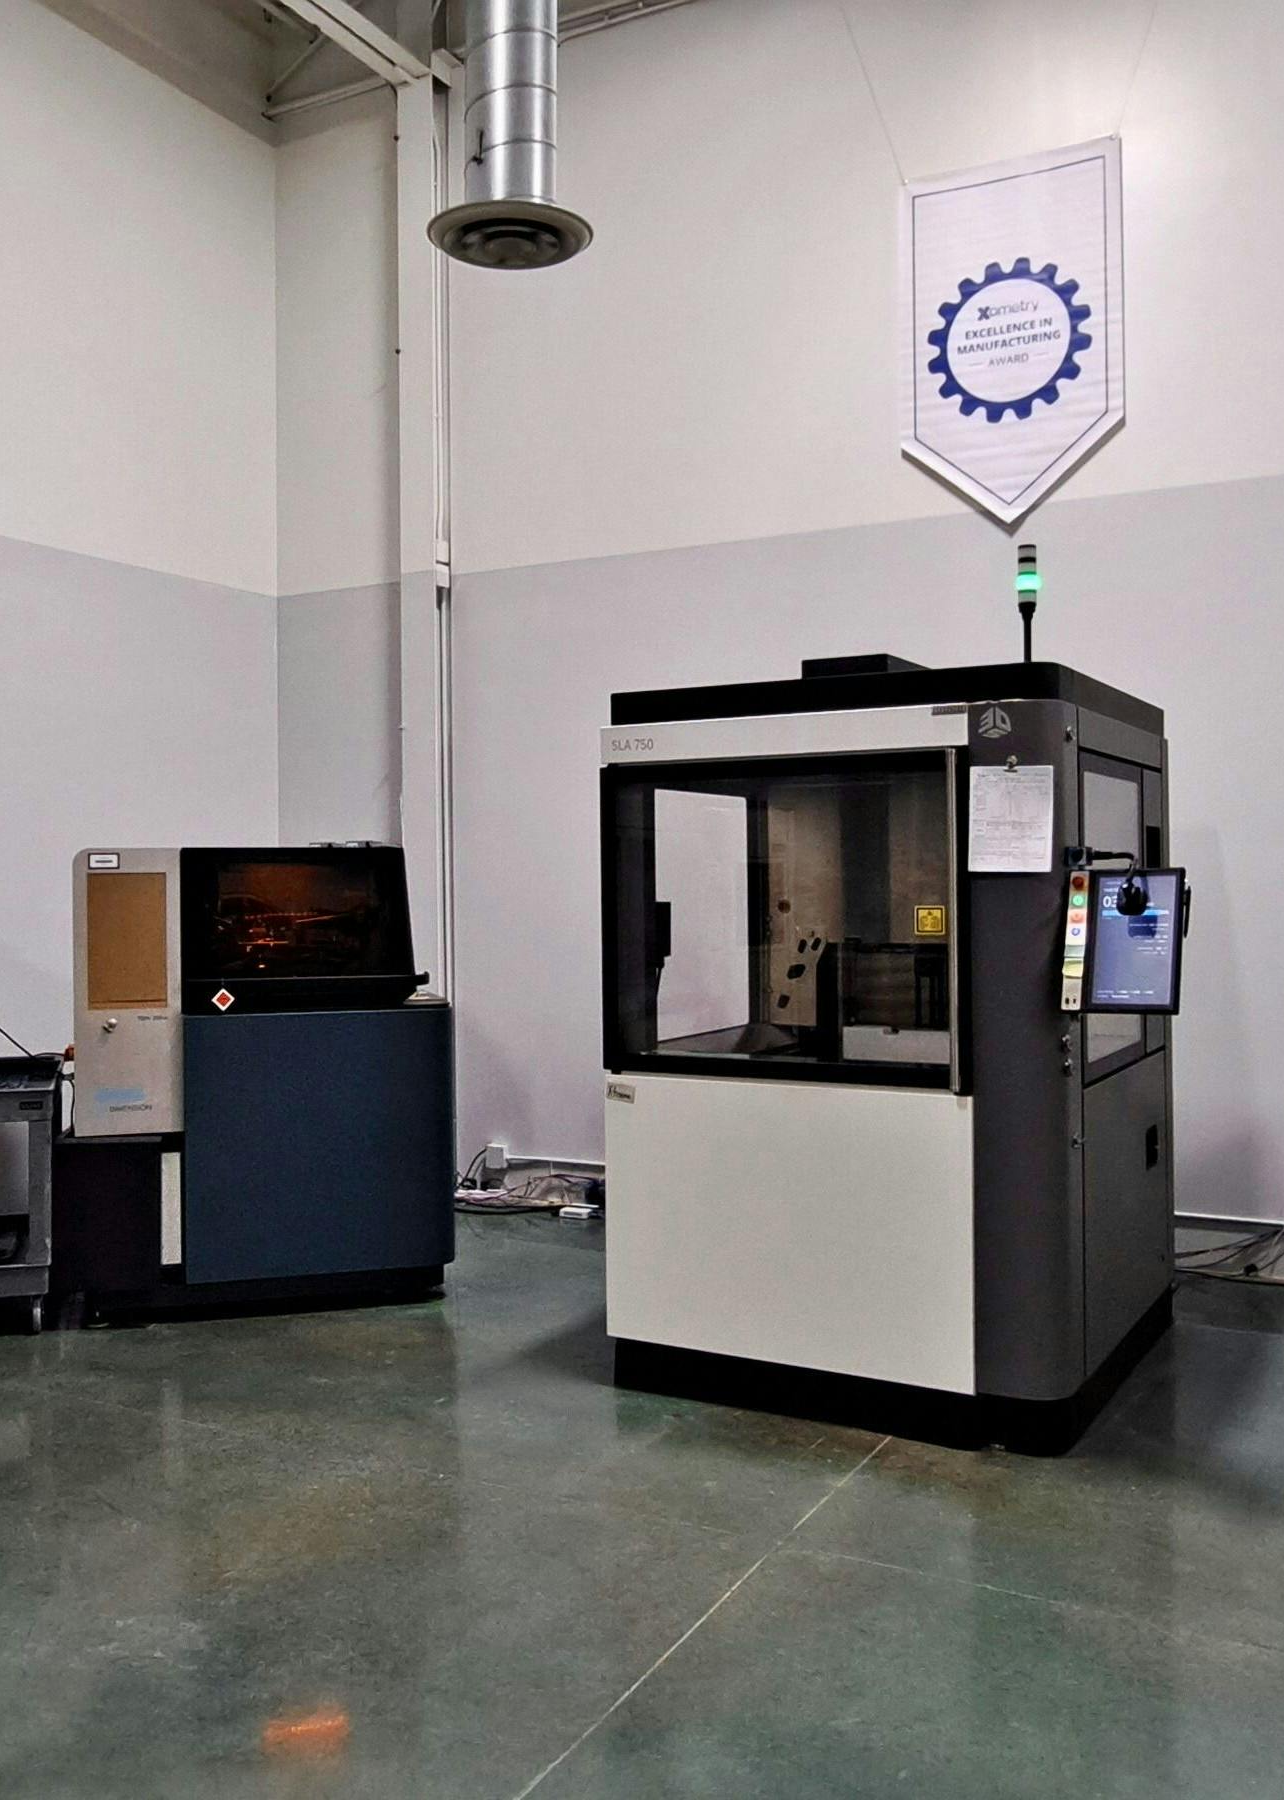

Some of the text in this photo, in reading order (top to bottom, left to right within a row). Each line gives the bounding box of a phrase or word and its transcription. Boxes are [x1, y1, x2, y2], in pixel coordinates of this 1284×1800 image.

[977, 300, 1039, 321] Xometry
[965, 317, 1053, 340] EXCELLENCE IN
[957, 330, 1061, 355] MANUFACTURING
[988, 353, 1030, 367] AWARD
[611, 738, 654, 752] SLA 750
